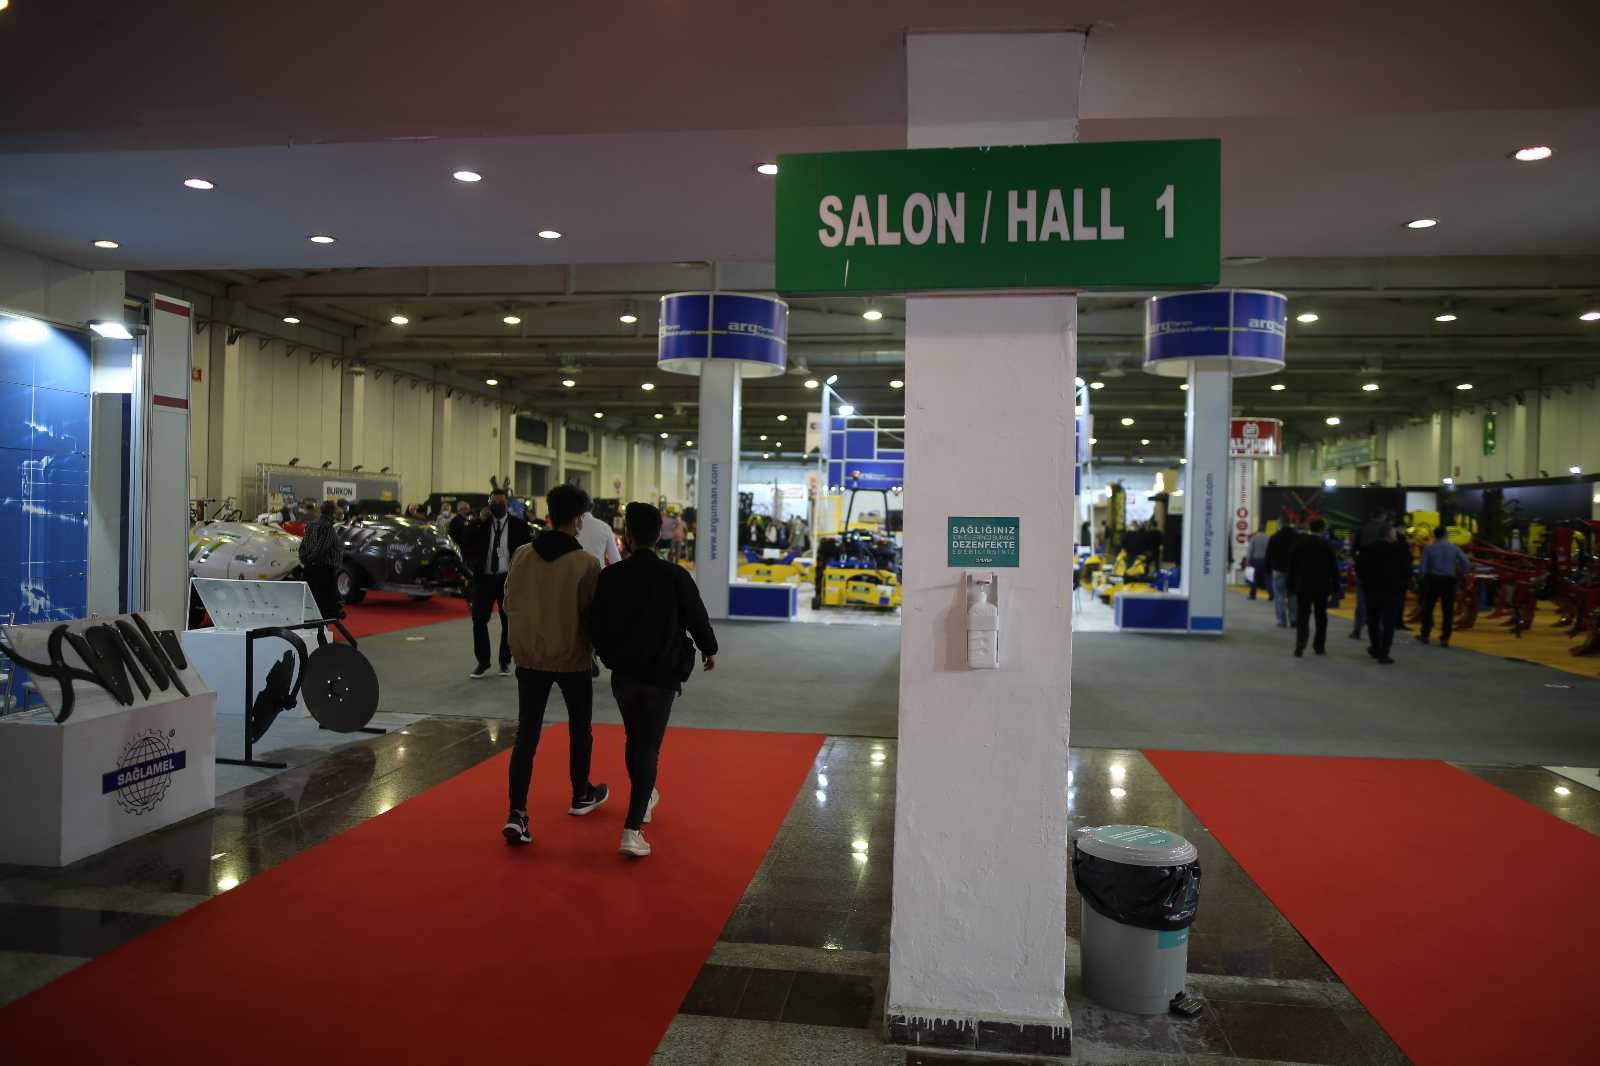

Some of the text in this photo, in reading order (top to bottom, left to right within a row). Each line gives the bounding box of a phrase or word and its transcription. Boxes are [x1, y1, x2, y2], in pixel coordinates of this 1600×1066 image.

[818, 185, 1175, 247] SALON / HALL 1
[327, 487, 352, 496] BURKON
[952, 541, 1015, 549] DEZENFEKTE
[117, 758, 175, 786] SAĞLAMEL
